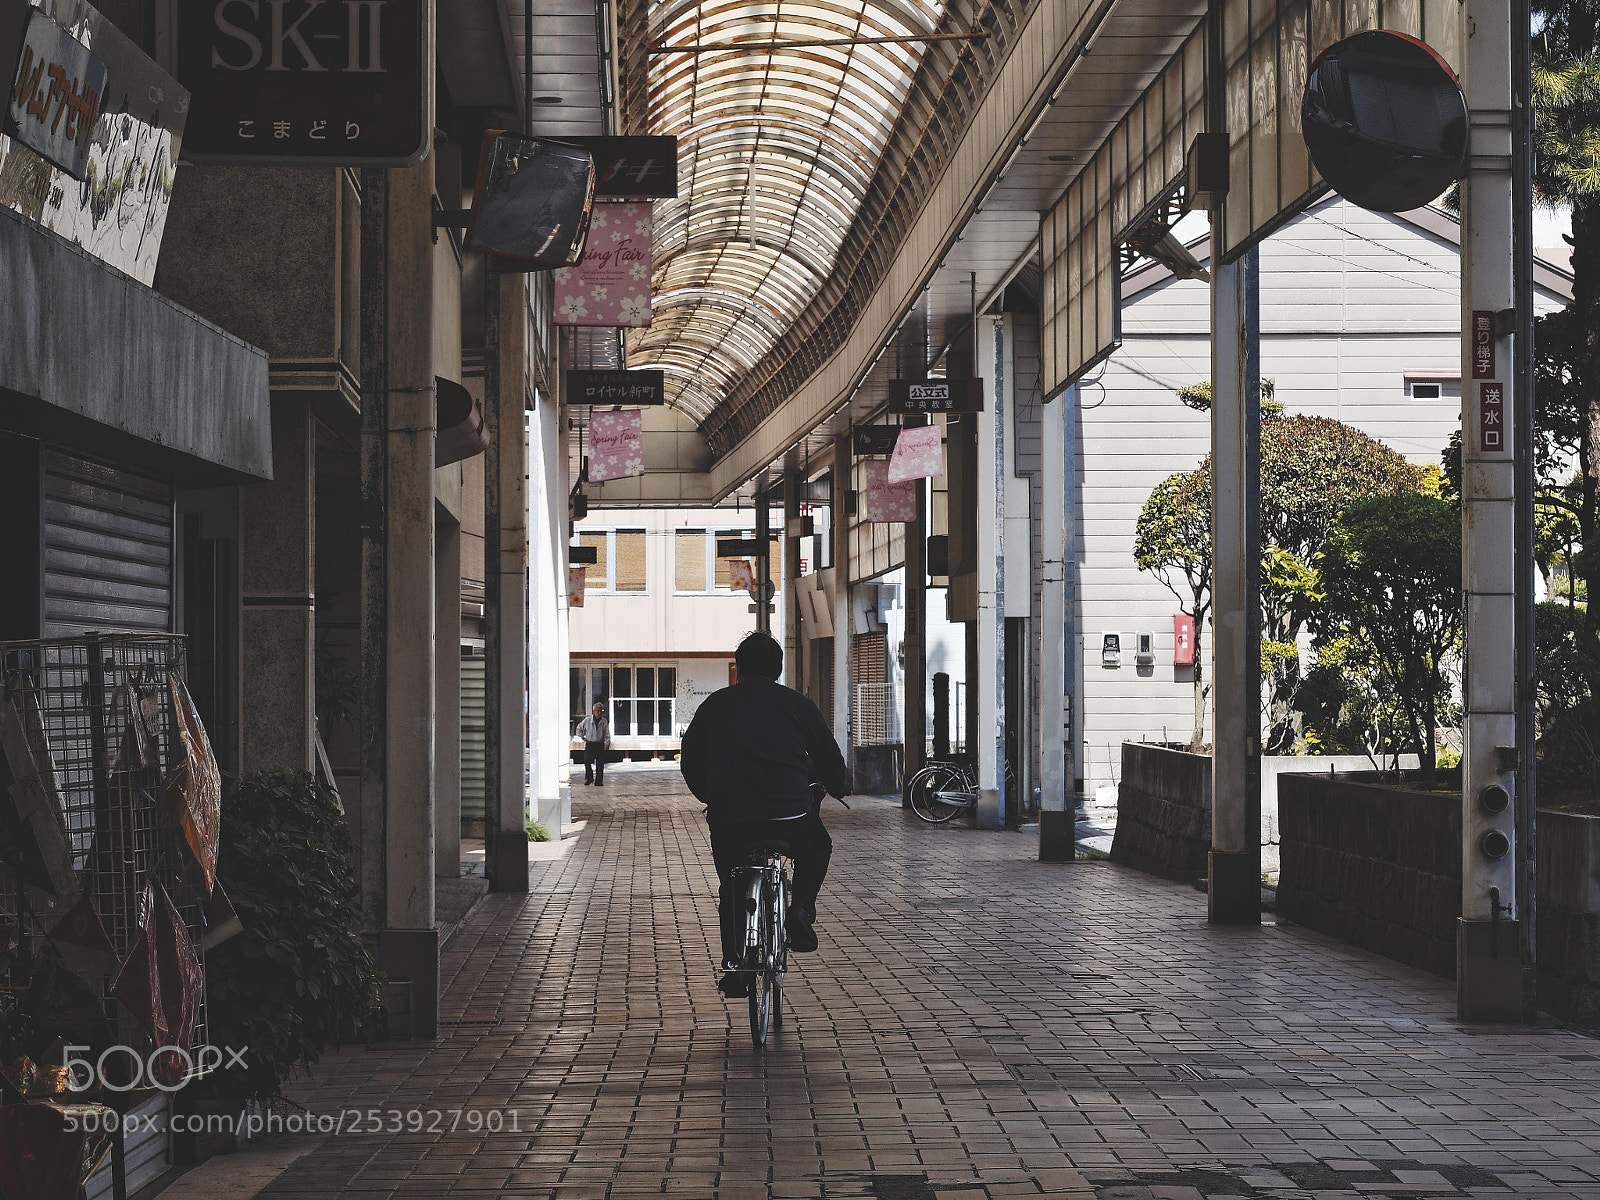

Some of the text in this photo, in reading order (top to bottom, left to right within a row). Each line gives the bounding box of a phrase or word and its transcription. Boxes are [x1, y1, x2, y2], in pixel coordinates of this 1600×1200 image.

[211, 0, 388, 72] SK-II
[238, 120, 360, 140] こまどり
[582, 239, 645, 269] ring Fair
[1476, 317, 1491, 373] 登り梯子
[585, 384, 656, 399] ロイヤル新町
[911, 387, 947, 398] 公文式
[905, 400, 953, 409] 中央教室
[1484, 388, 1501, 446] 送水口
[590, 428, 639, 448] Spring Fair
